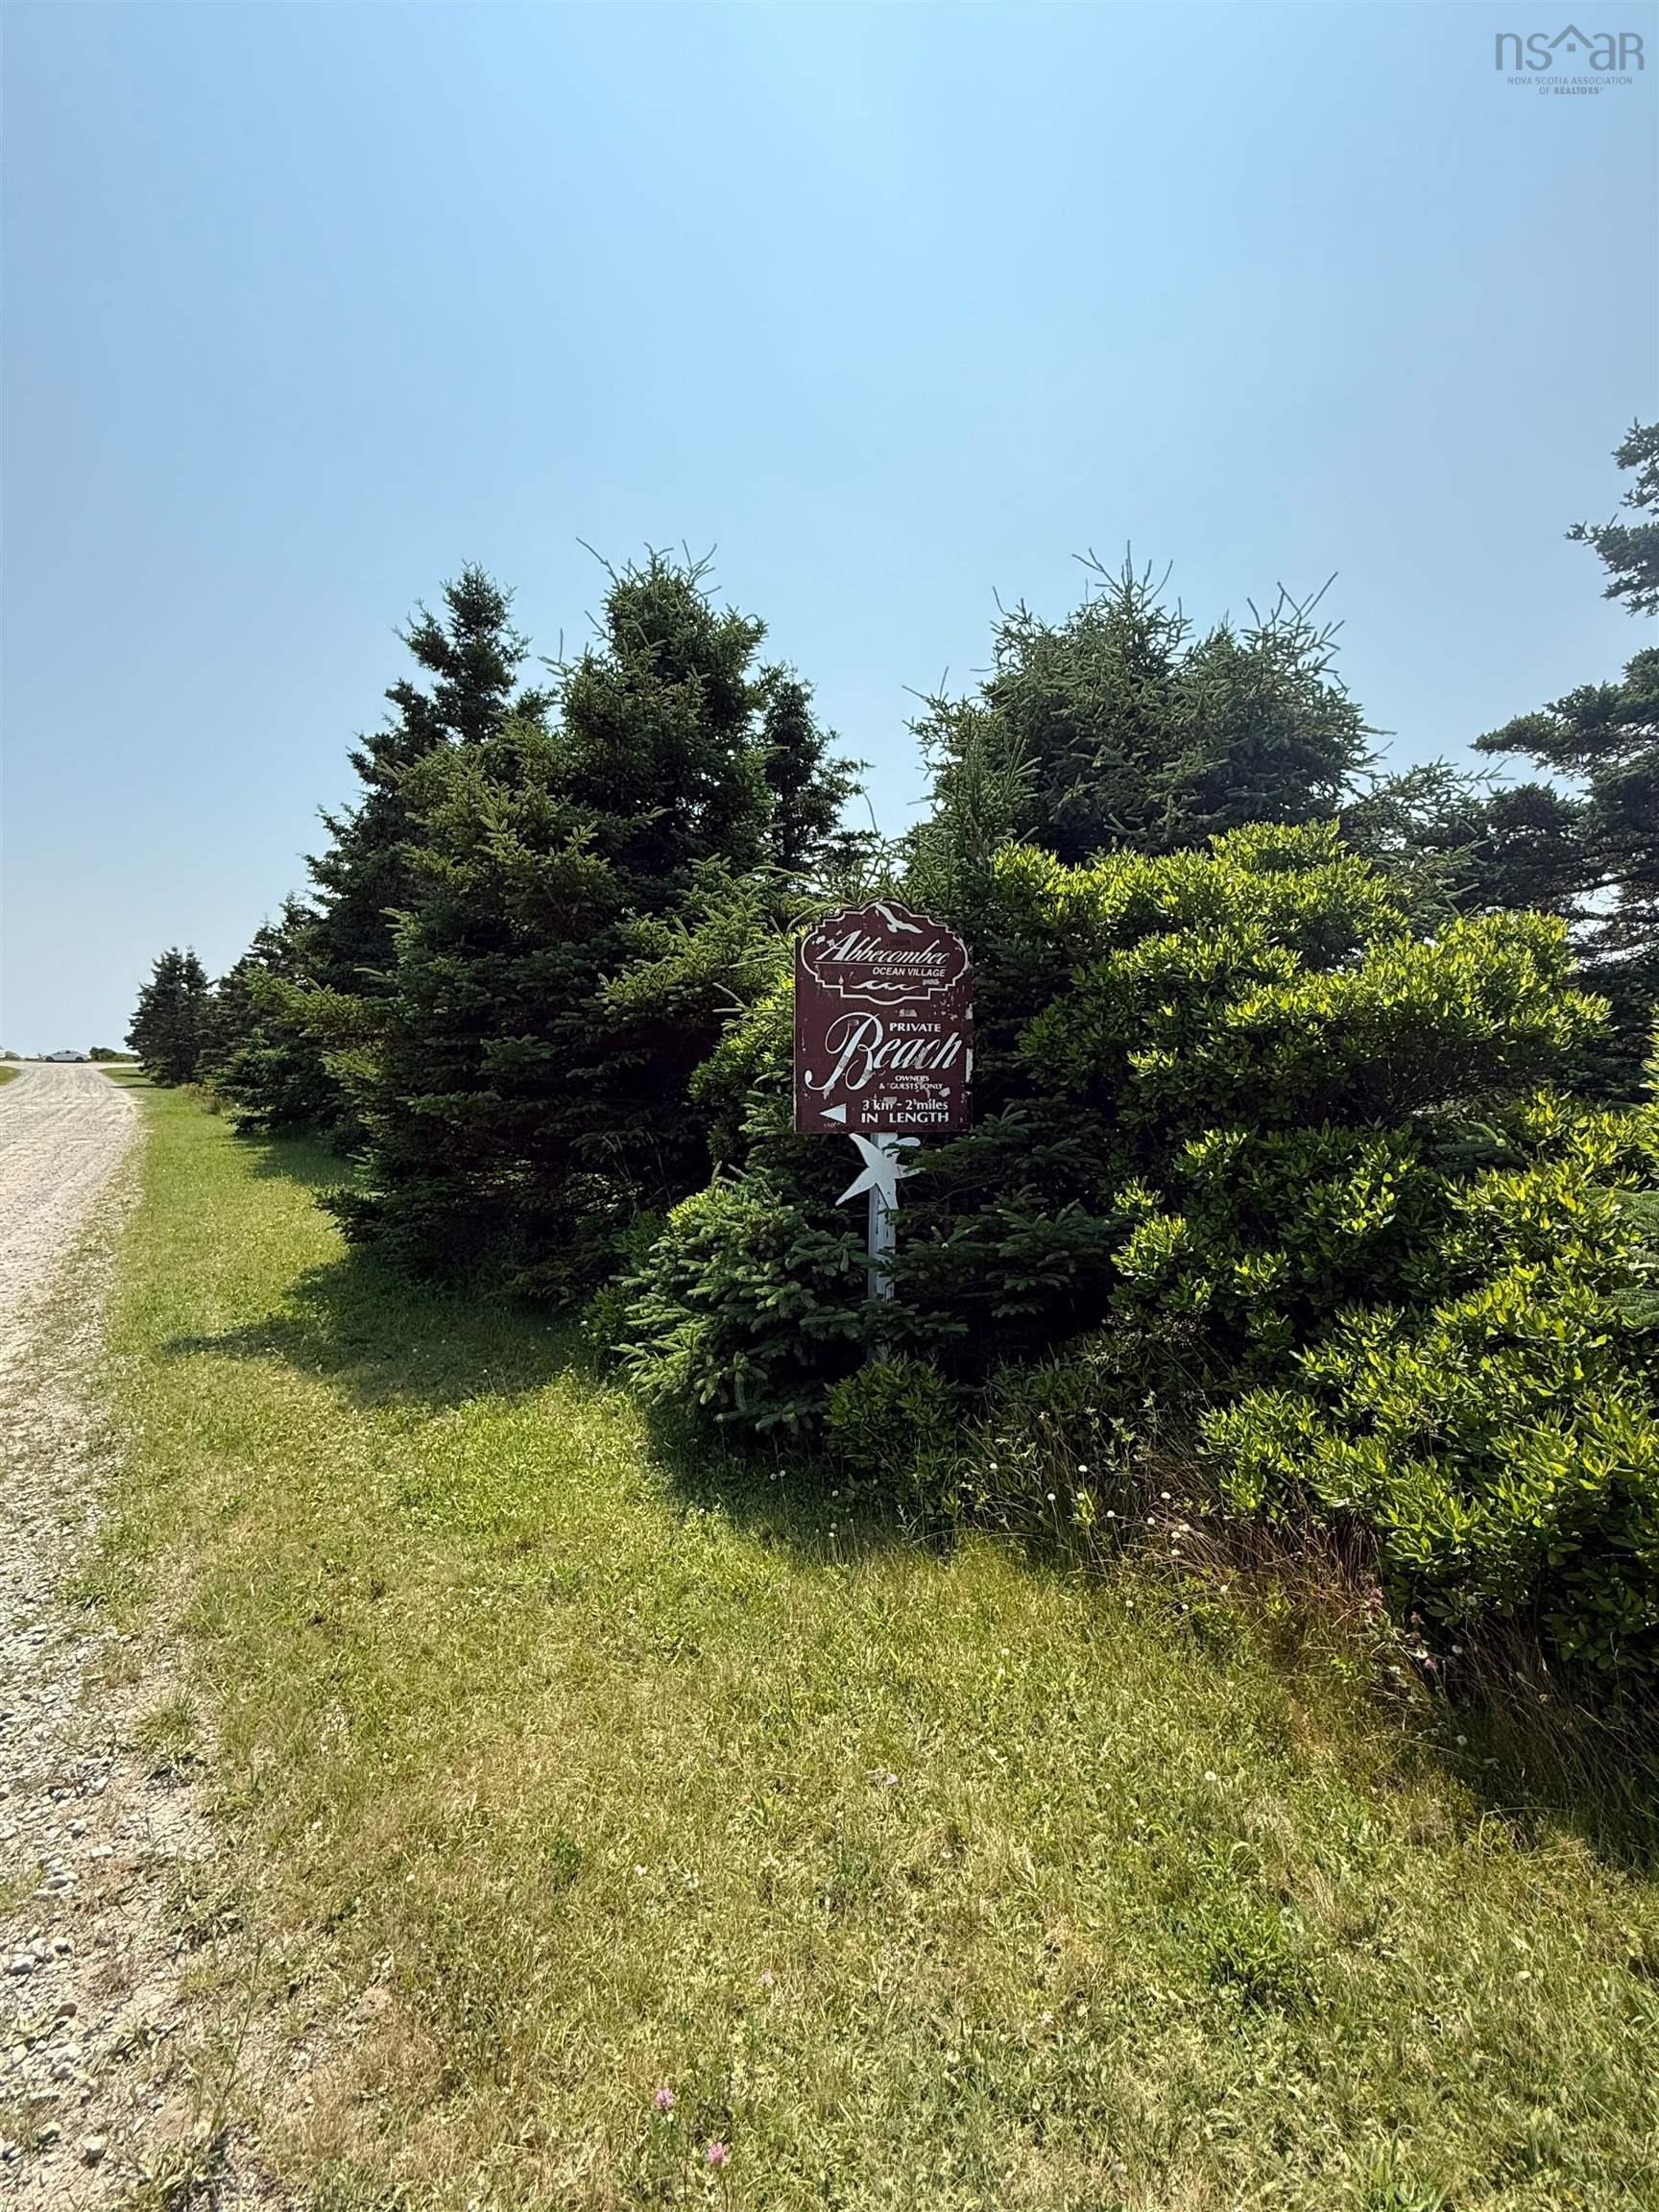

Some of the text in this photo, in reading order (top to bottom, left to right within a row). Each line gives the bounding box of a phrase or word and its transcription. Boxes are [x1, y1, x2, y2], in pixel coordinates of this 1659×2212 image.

[872, 967, 946, 977] OCEAN VILLAGE
[889, 1022, 942, 1032] PRIVATE
[805, 1012, 963, 1091] Beach
[862, 1099, 870, 1111] 3
[874, 1099, 893, 1111] km
[905, 1099, 914, 1111] 2
[916, 1098, 949, 1111] miles
[861, 1112, 950, 1123] IN LENGTH
